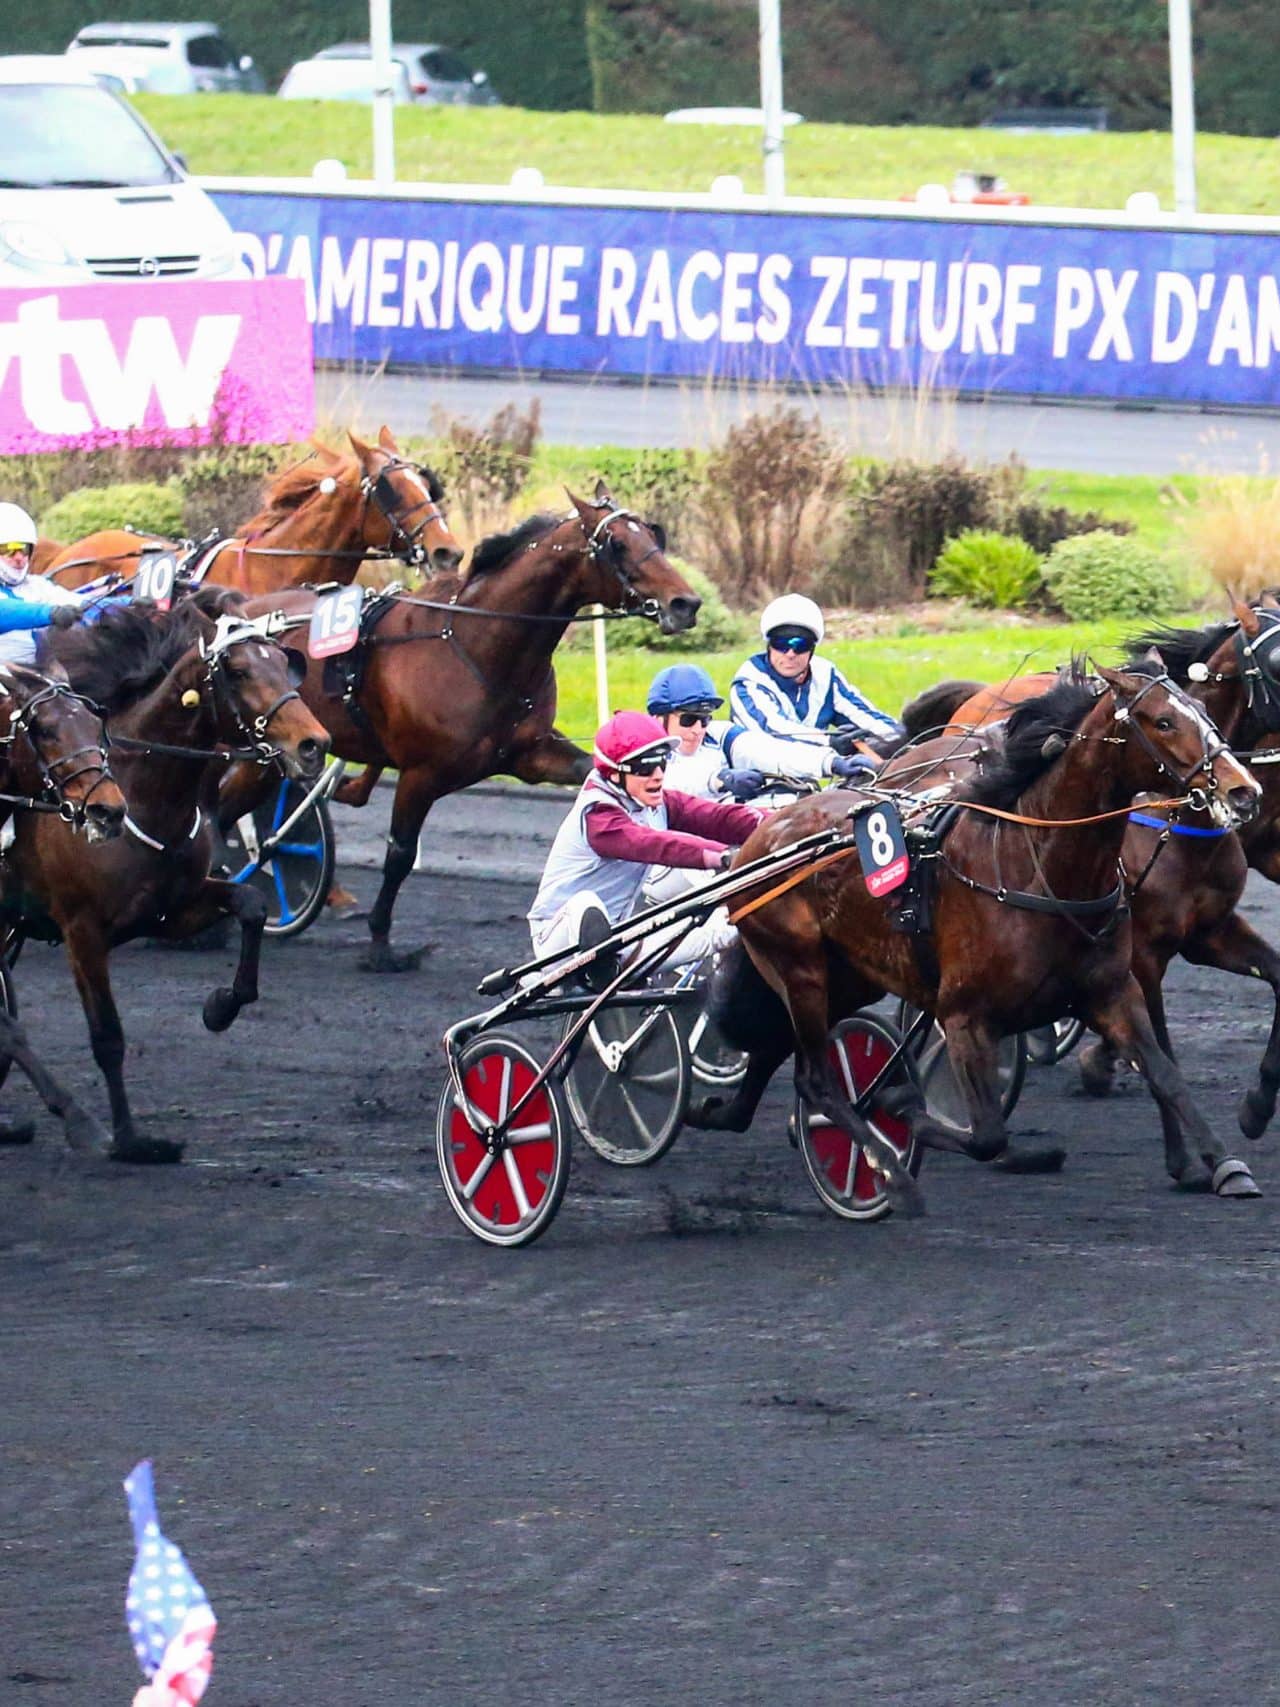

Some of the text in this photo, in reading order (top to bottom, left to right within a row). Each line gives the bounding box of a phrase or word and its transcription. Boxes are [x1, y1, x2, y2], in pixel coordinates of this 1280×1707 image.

[596, 246, 793, 344] RACES
[805, 256, 1042, 355] ZETURF
[1053, 266, 1138, 361] PX
[140, 558, 173, 599] 10
[318, 591, 357, 638] 15
[867, 812, 895, 867] 8
